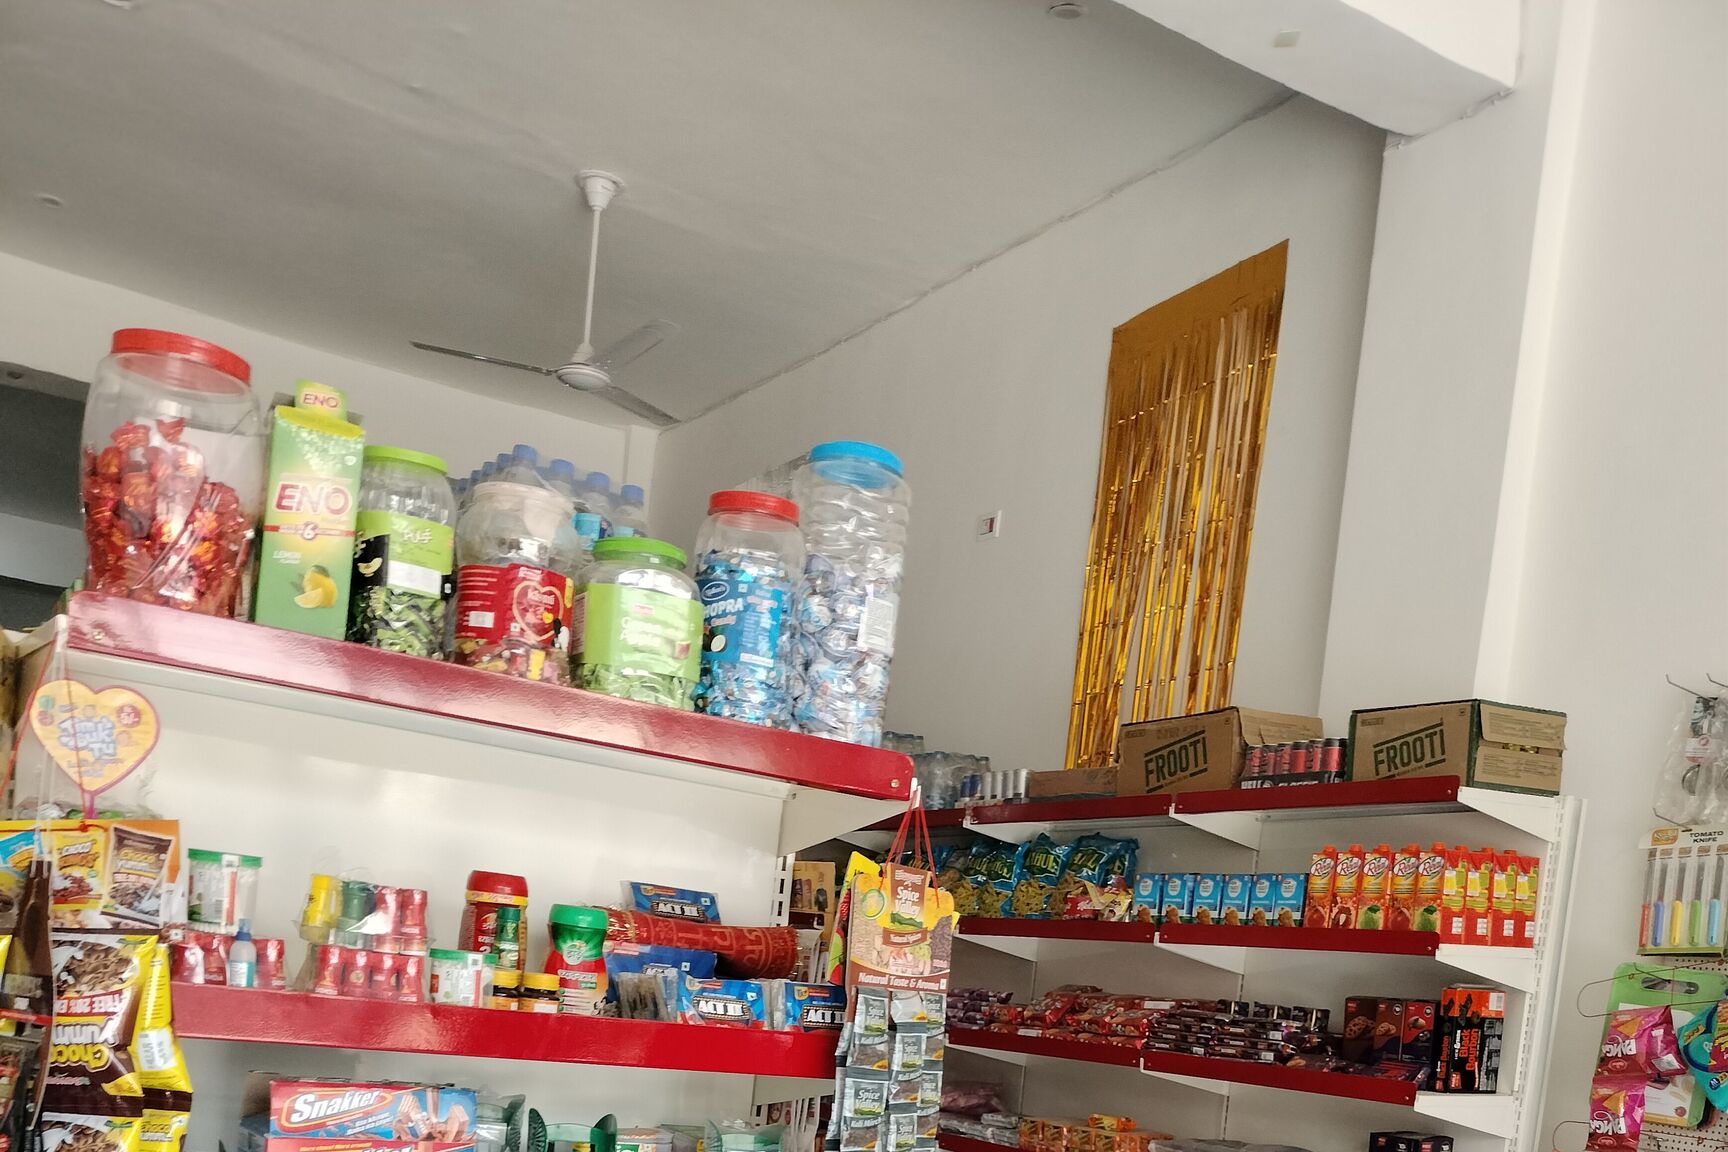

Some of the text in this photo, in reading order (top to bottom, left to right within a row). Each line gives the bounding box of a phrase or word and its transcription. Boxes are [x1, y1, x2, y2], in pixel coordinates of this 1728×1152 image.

[303, 393, 339, 409] ENO
[275, 483, 351, 515] ENO
[1144, 737, 1208, 786] FROOTI
[1374, 728, 1446, 776] FROOTI
[1689, 829, 1724, 838] TOMATO
[896, 886, 920, 904] Spice
[699, 1000, 725, 1015] ACT
[807, 1008, 832, 1023] ACT
[50, 1043, 110, 1069] Choc
[1459, 1029, 1470, 1057] Black
[1466, 1029, 1479, 1071] Bourbon
[290, 1091, 381, 1124] Snakker
[858, 1090, 880, 1101] Spice
